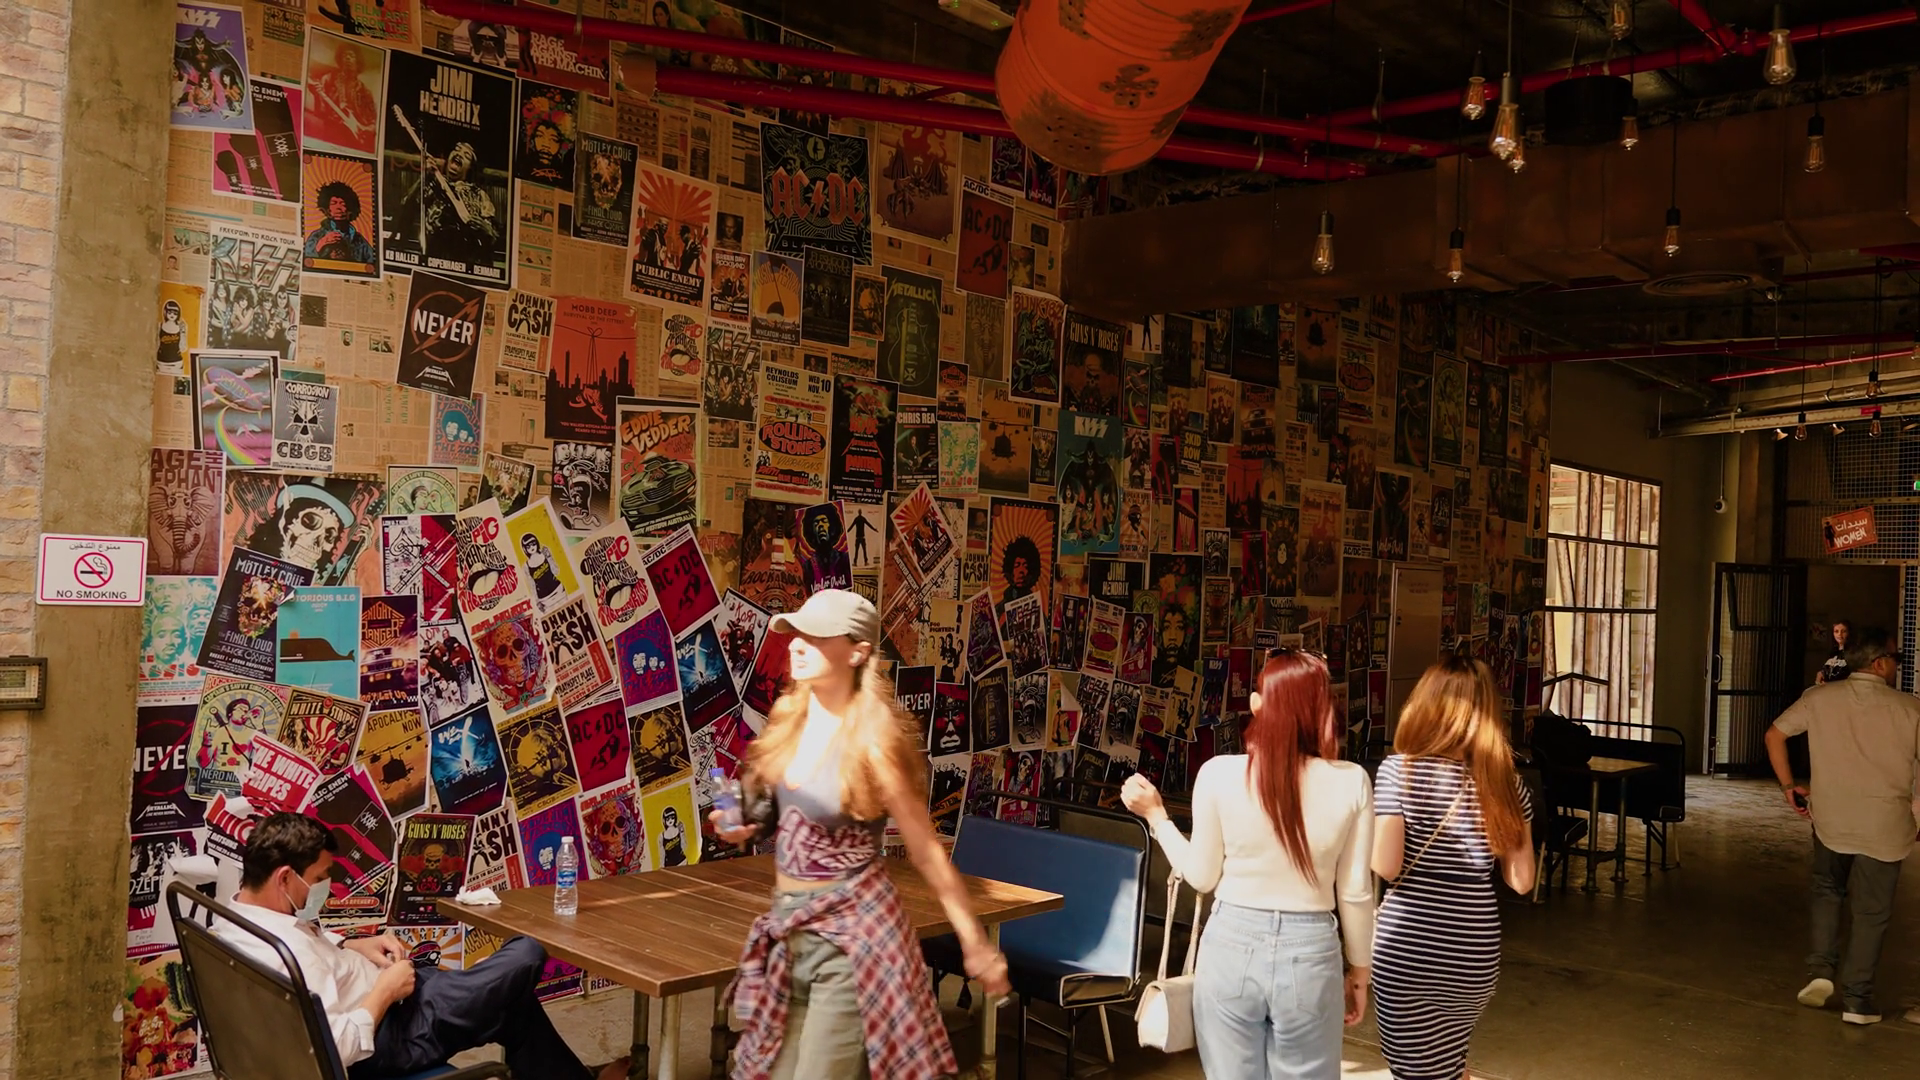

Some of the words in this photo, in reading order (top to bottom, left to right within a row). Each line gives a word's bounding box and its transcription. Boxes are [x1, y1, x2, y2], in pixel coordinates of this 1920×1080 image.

[530, 31, 565, 51] RAGE
[530, 43, 578, 63] AGAINST
[531, 54, 556, 69] THE
[430, 64, 473, 102] JIMI
[419, 90, 480, 126] HENDRIX
[964, 180, 990, 197] AC/DC
[219, 226, 250, 238] FREEDOM
[251, 231, 260, 240] TO
[261, 235, 278, 244] ROCK
[279, 237, 296, 247] TOUR
[427, 257, 467, 273] COPENHAGEN
[635, 262, 670, 280] PUBLIC
[671, 270, 702, 288] ENEMY
[512, 292, 553, 311] JOHNNY
[571, 304, 595, 314] MOBB
[597, 307, 618, 317] DEEP
[413, 308, 474, 346] NEVER
[1070, 320, 1089, 345] GUNS
[1097, 327, 1119, 353] ROSES
[766, 365, 799, 380] REYNOLDS
[767, 373, 798, 387] COLISEUM
[285, 382, 330, 400] CORROSION
[808, 375, 820, 385] WED
[821, 379, 831, 393] 10
[808, 384, 820, 394] NOV.
[897, 412, 921, 424] CHRIS
[921, 412, 936, 424] REA
[1018, 406, 1032, 419] NOW
[620, 410, 663, 443] EDDIE
[631, 415, 691, 454] VEDDER
[763, 422, 821, 442] ROLLING
[1074, 414, 1109, 438] KISS
[771, 436, 822, 455] STONES
[1184, 430, 1202, 447] SKID
[151, 448, 202, 470] AGE
[276, 441, 332, 462] CBGB
[1183, 445, 1201, 461] ROW
[471, 516, 499, 544] PIG
[1835, 517, 1868, 531] سيدات
[1834, 527, 1867, 548] WOMEN
[605, 535, 629, 562] PIG
[642, 546, 667, 565] AC/DC
[966, 553, 988, 562] JOHNNY
[235, 557, 278, 579] MÖTLEY
[1106, 562, 1127, 581] JIMI
[56, 590, 73, 598] NO
[76, 590, 127, 599] SMOKING
[1102, 580, 1130, 596] HENDRIX
[368, 604, 392, 620] NIGHT
[541, 599, 586, 634] OHNNY
[225, 630, 248, 647] FINAL
[249, 638, 273, 653] TOUR
[362, 620, 399, 645] RANGER
[546, 612, 598, 666] ASH
[1257, 635, 1275, 645] oasis
[897, 692, 931, 712] NEVER
[290, 702, 322, 715] WHITE
[329, 705, 358, 728] STRIPES
[401, 716, 422, 734] NOW
[202, 769, 225, 781] NERD
[271, 754, 317, 790] WHITE
[328, 772, 352, 792] ENEMY
[407, 823, 430, 839] GUNS
[441, 824, 467, 840] ROSES
